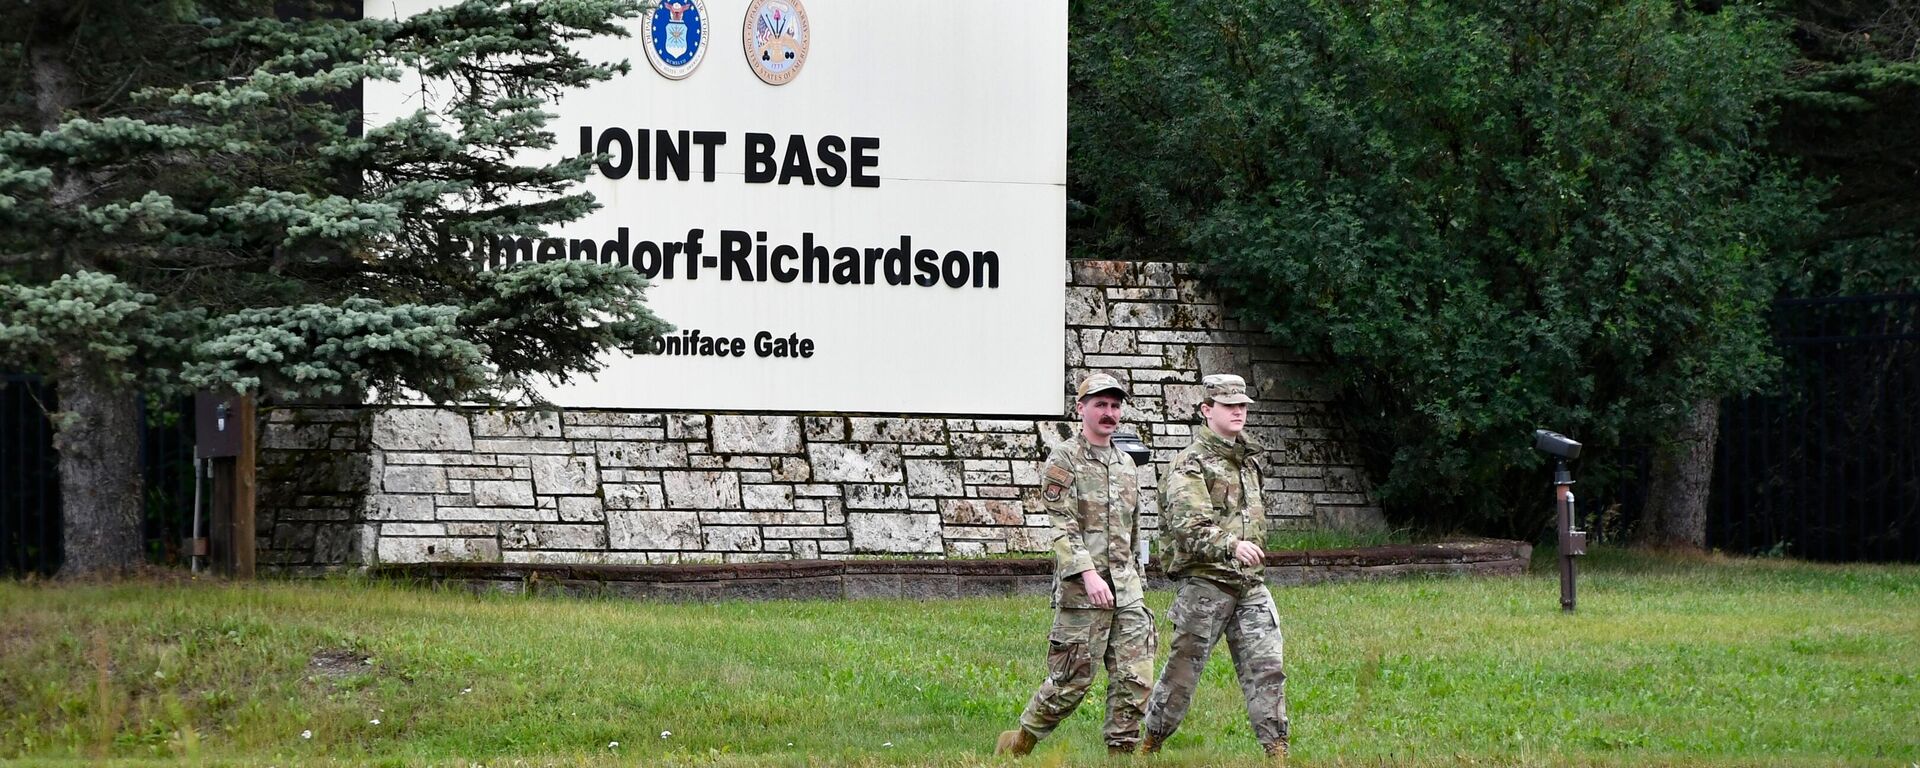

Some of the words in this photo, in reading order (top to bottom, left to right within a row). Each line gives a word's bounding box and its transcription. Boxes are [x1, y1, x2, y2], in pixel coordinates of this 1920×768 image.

[745, 133, 880, 188] BASE
[438, 224, 999, 288] mendorf-Richardson
[633, 328, 746, 357] oniface
[754, 331, 814, 358] Gate
